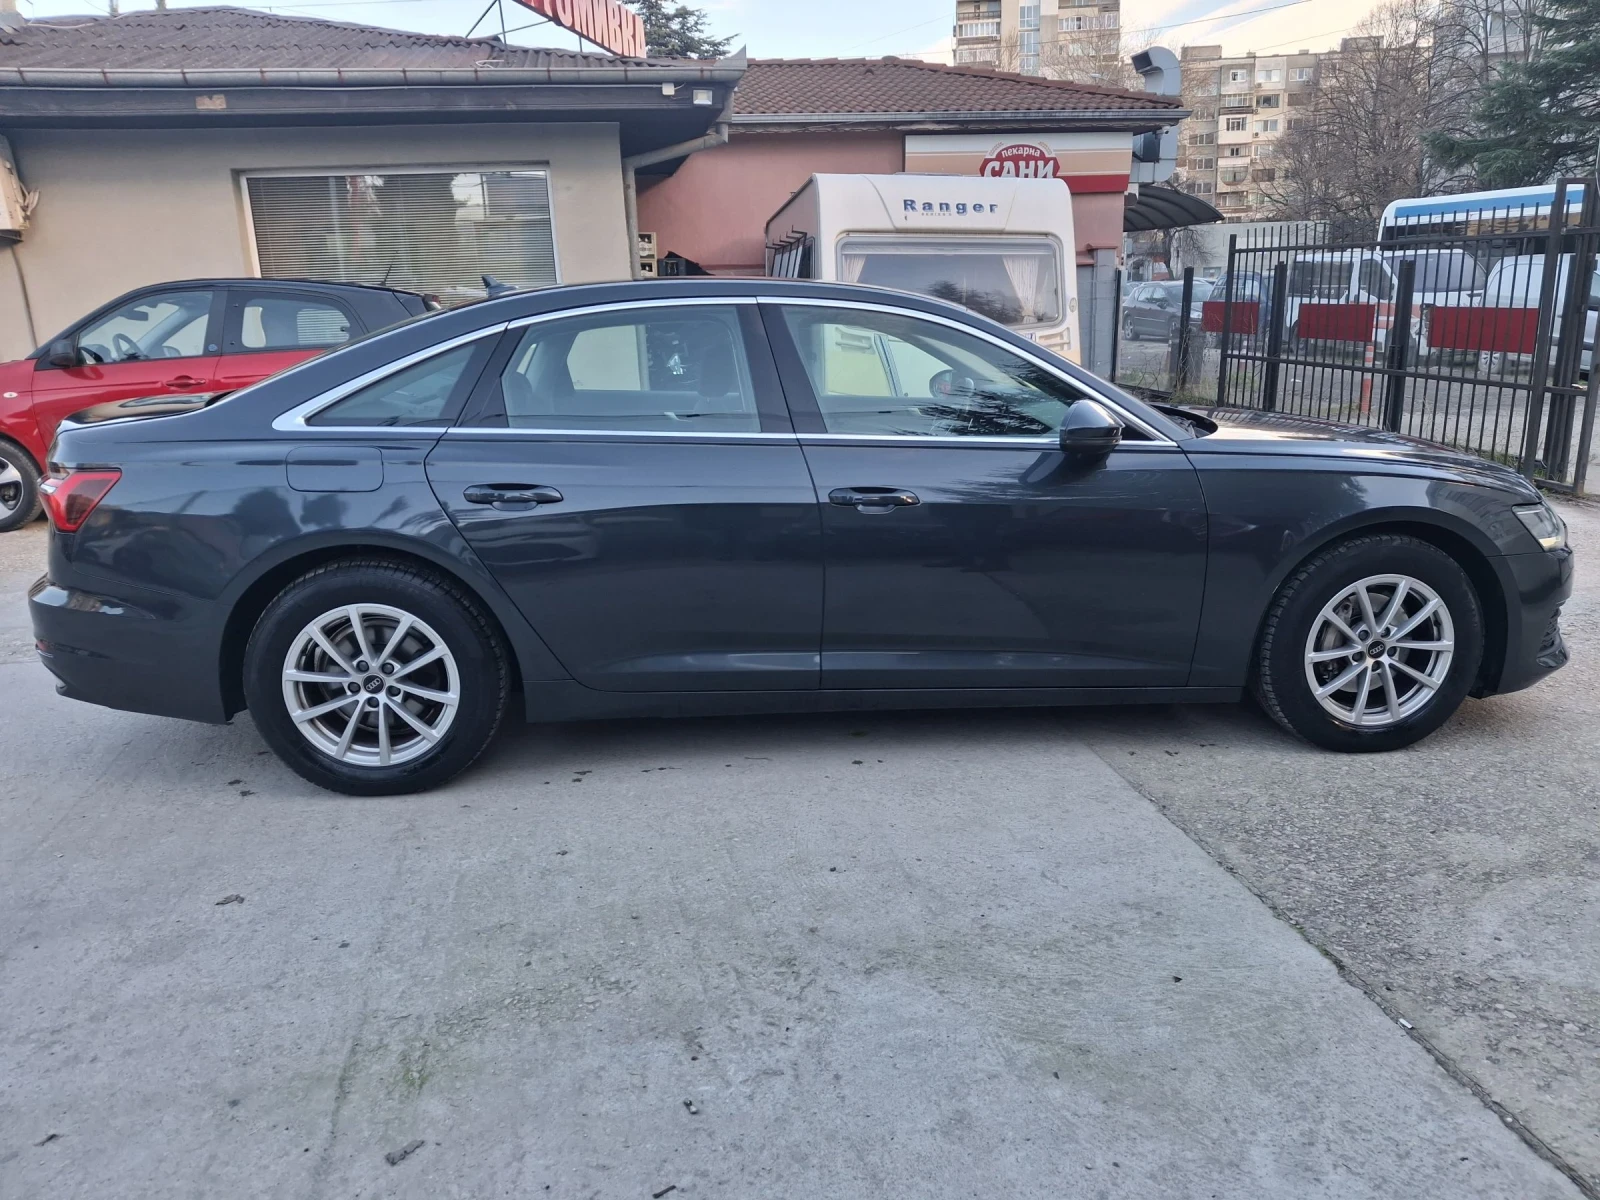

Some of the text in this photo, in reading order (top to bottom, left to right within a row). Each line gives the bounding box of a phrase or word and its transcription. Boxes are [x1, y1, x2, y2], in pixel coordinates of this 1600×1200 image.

[1001, 147, 1040, 158] пекарна
[984, 160, 1054, 178] САНИ
[903, 199, 999, 216] Ranger
